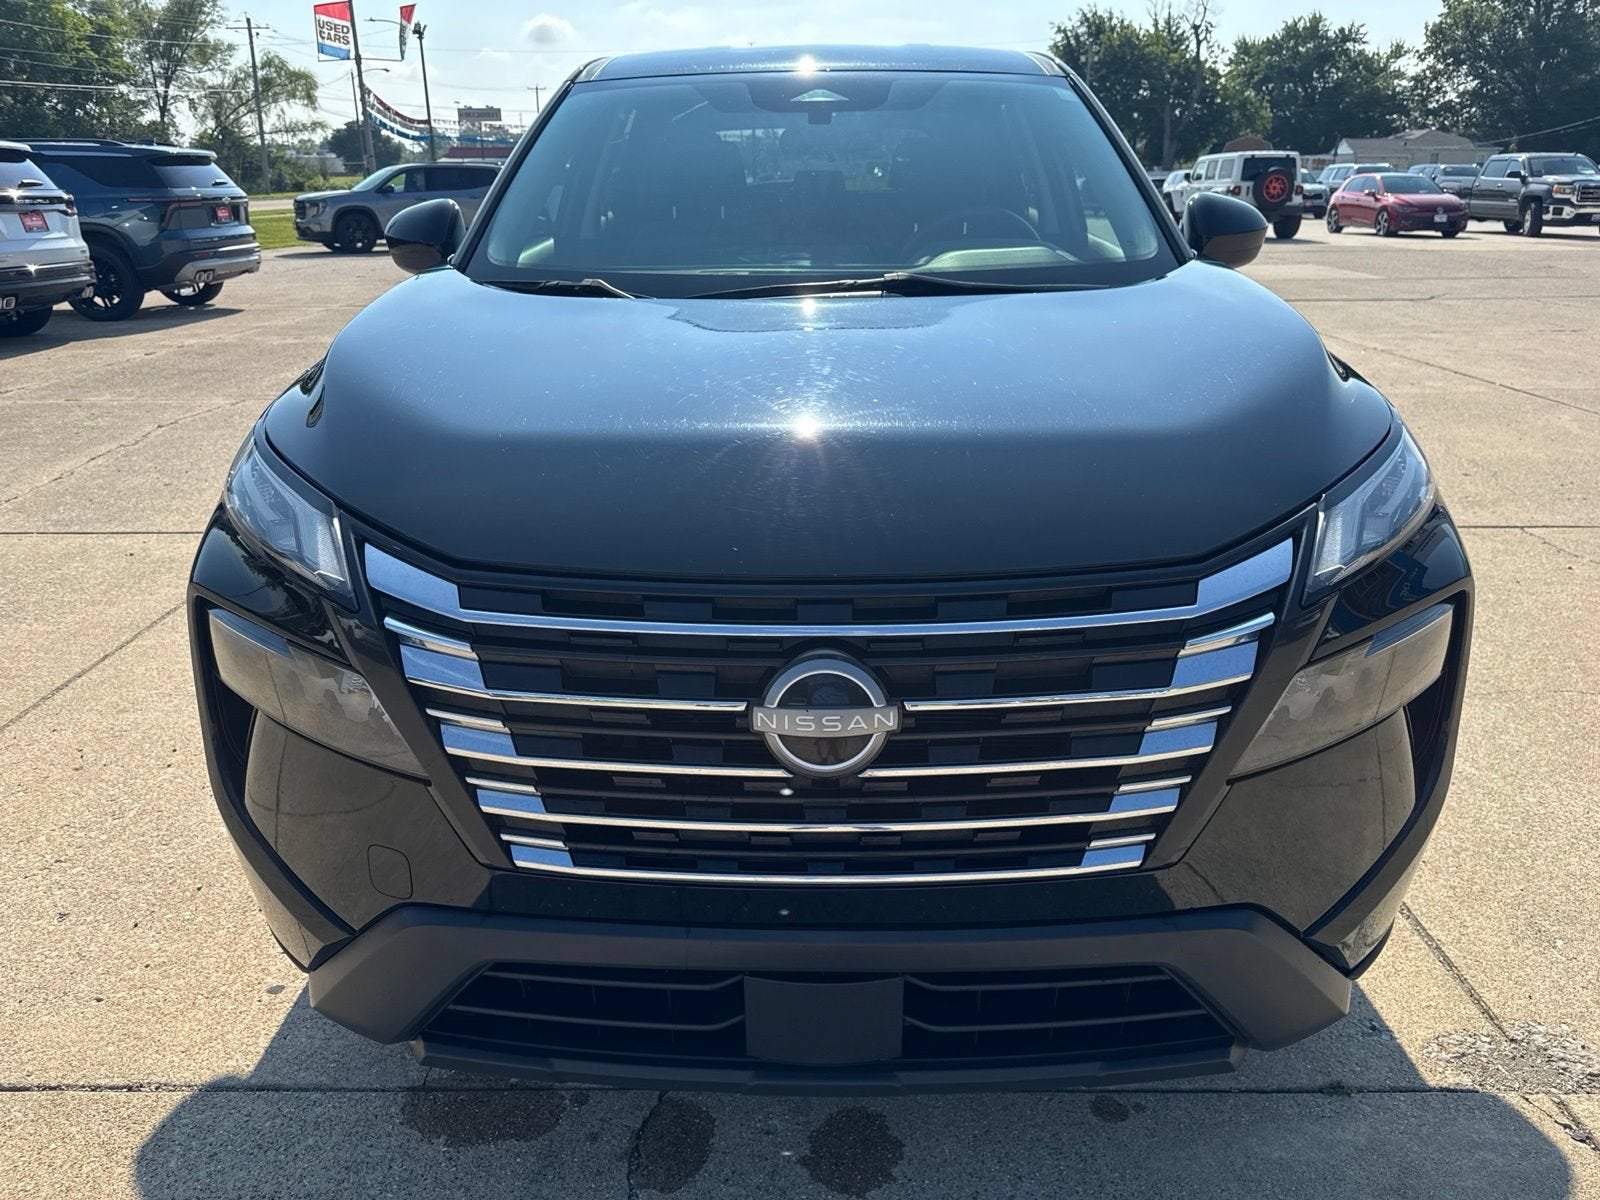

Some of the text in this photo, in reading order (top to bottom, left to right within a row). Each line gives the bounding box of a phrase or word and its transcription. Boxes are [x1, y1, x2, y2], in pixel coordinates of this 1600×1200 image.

[317, 19, 350, 35] USED
[318, 30, 350, 46] CARS
[757, 711, 894, 732] NISSAN
